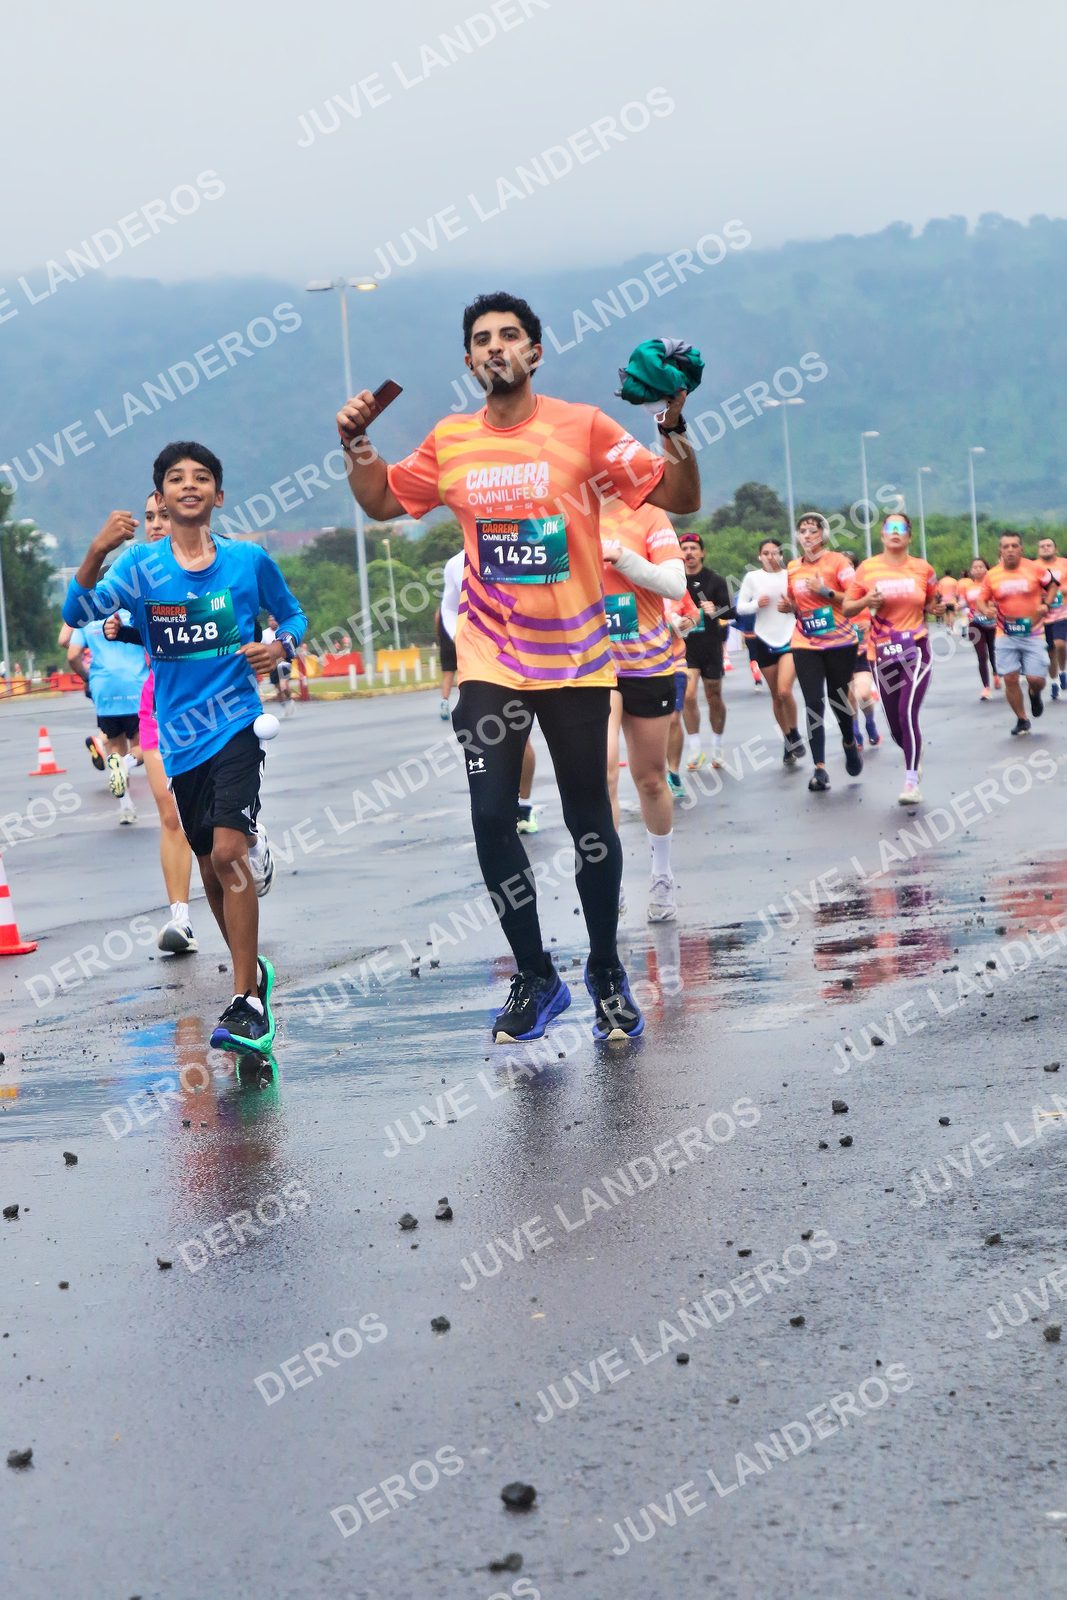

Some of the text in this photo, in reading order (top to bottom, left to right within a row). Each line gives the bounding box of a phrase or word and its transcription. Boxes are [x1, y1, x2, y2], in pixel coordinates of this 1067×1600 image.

[466, 461, 549, 490] CARRERA
[467, 486, 532, 505] OMNILIFE
[482, 520, 559, 536] CARRERA 10K
[482, 533, 511, 542] OMNILIFE
[494, 545, 547, 565] 1425
[151, 595, 226, 616] CARRERA 10K
[618, 596, 630, 607] 10K
[152, 614, 180, 623] OMNILIFE
[805, 617, 828, 629] 1156
[163, 621, 219, 645] 1428
